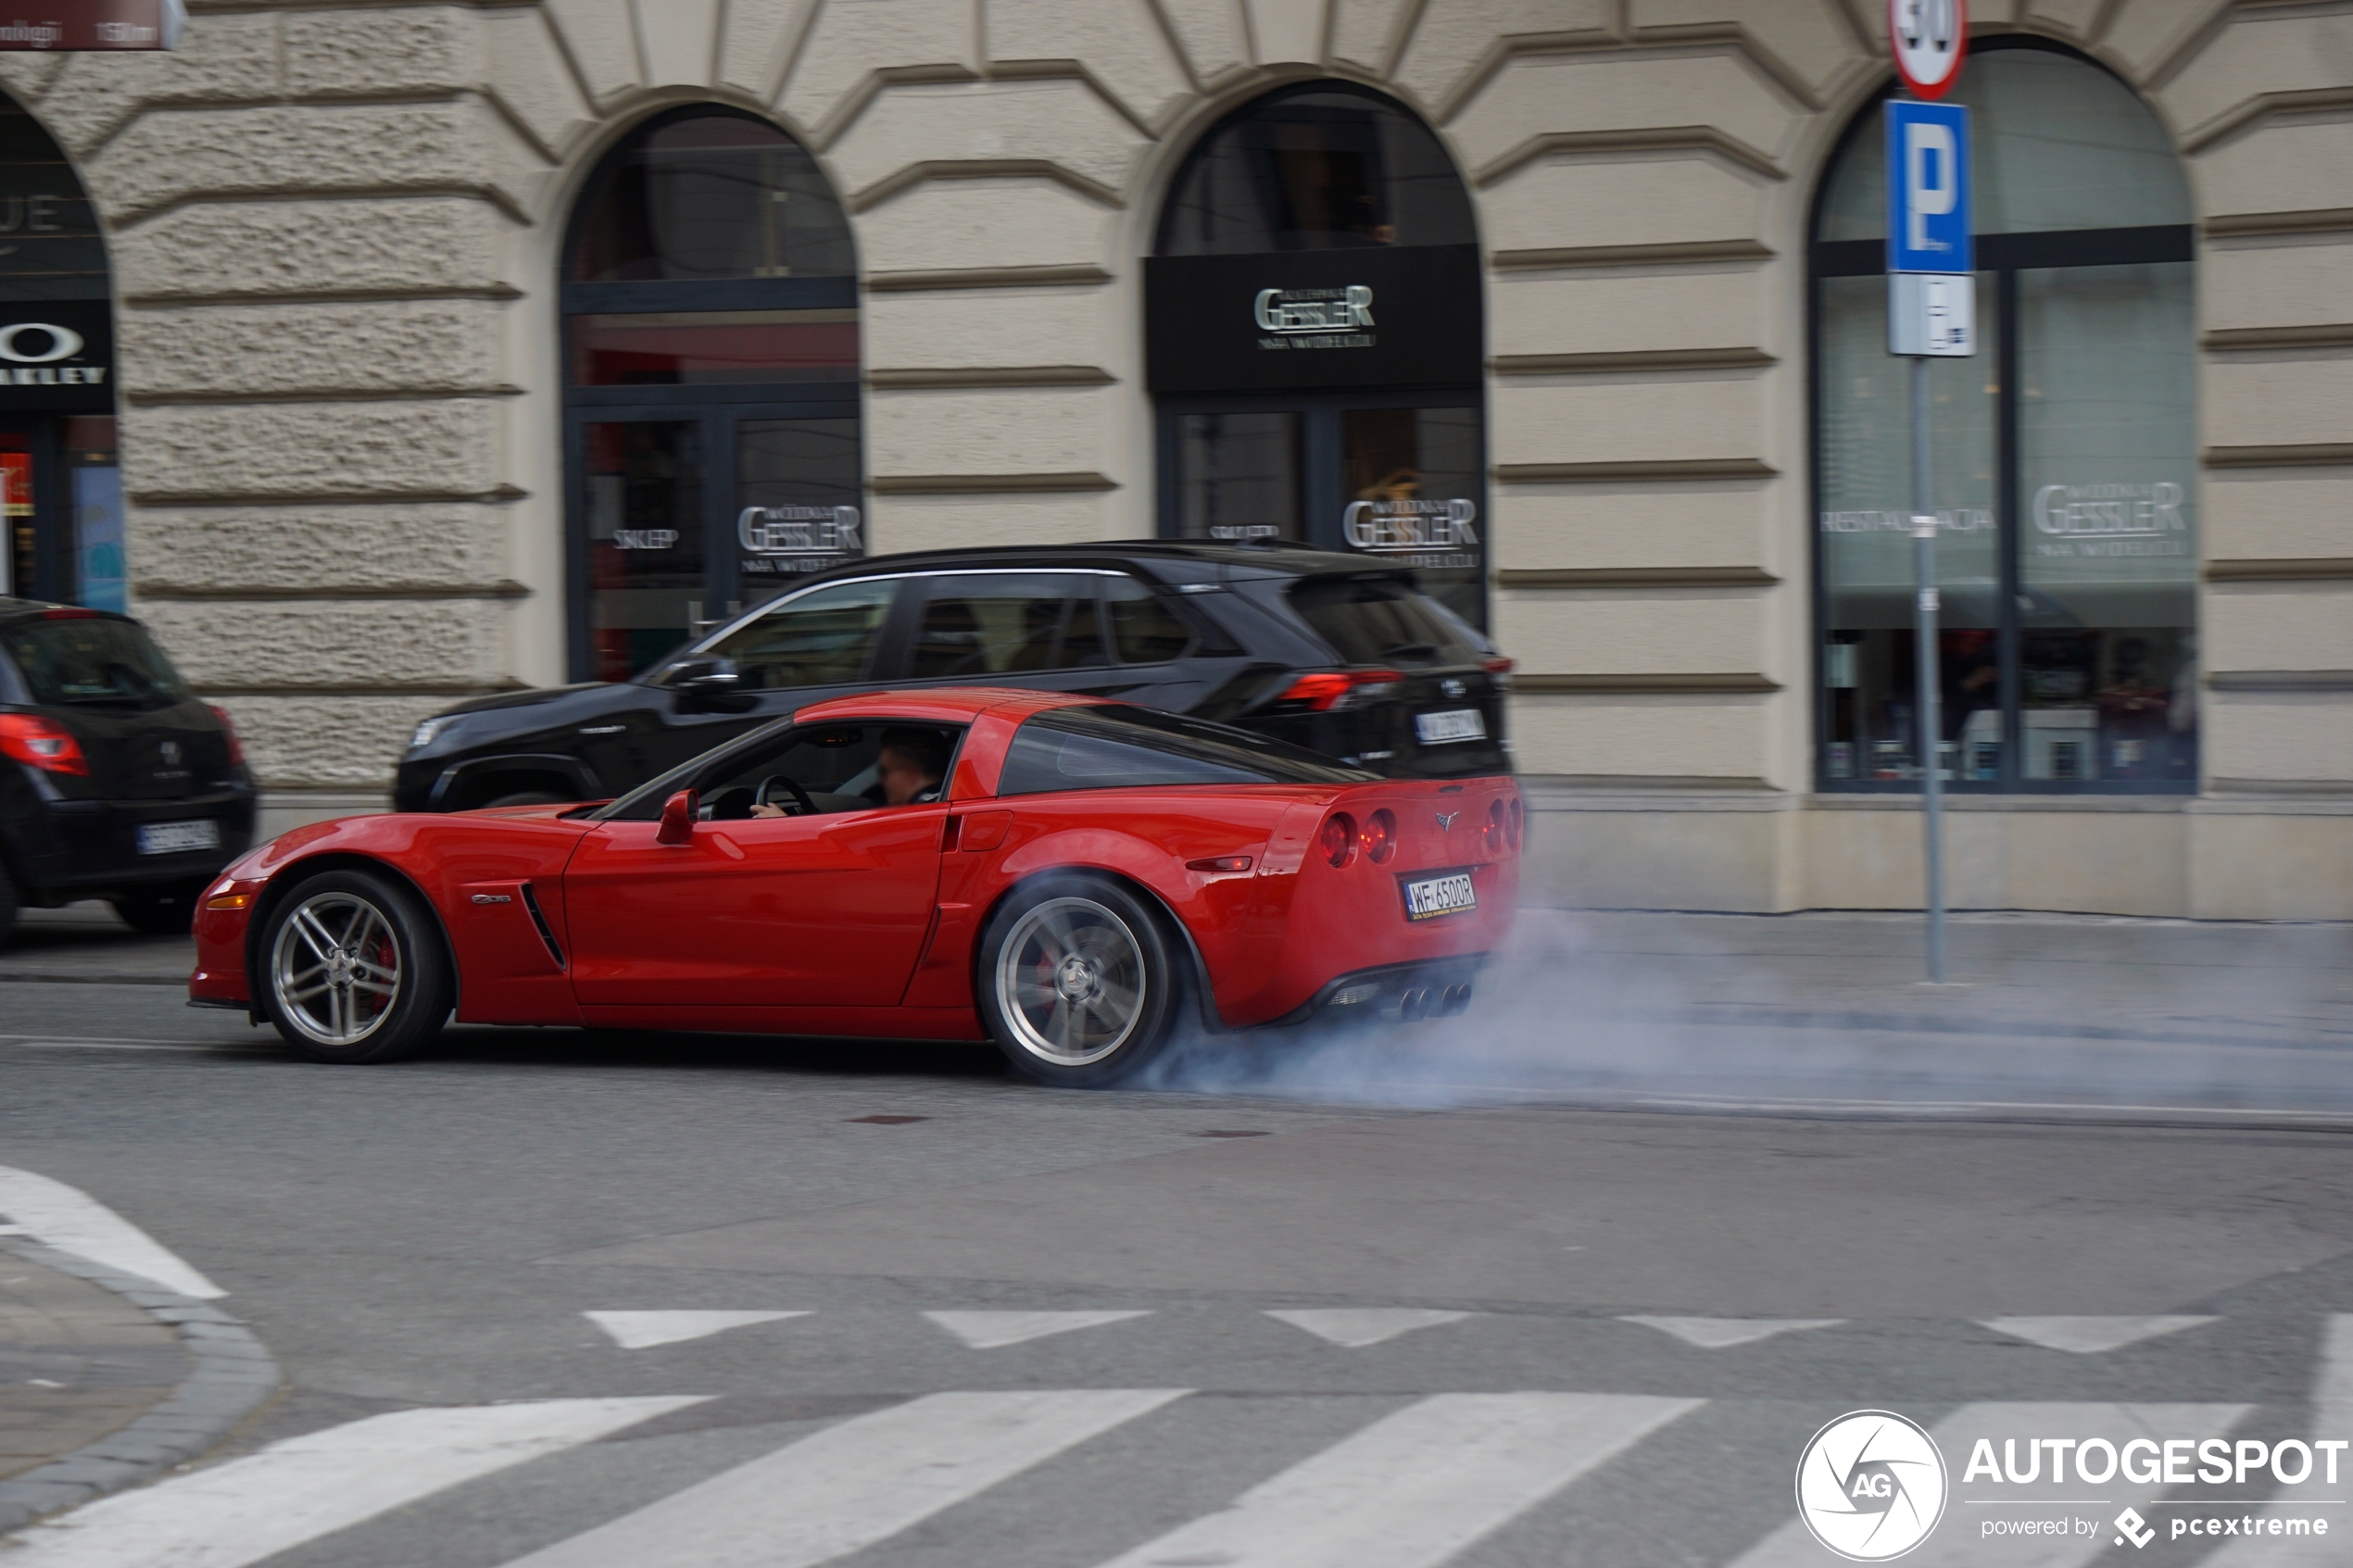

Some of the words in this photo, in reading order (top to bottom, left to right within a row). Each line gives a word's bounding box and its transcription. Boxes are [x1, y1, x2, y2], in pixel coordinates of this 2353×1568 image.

[1904, 122, 1958, 251] P
[1254, 285, 1375, 331] GESSLER
[737, 506, 862, 551] GESSLER
[1343, 498, 1479, 547] GESSLER
[2033, 482, 2187, 534] GESSLER
[613, 529, 680, 549] SKLEP
[472, 894, 511, 905] Z06
[1436, 877, 1474, 909] 6500R
